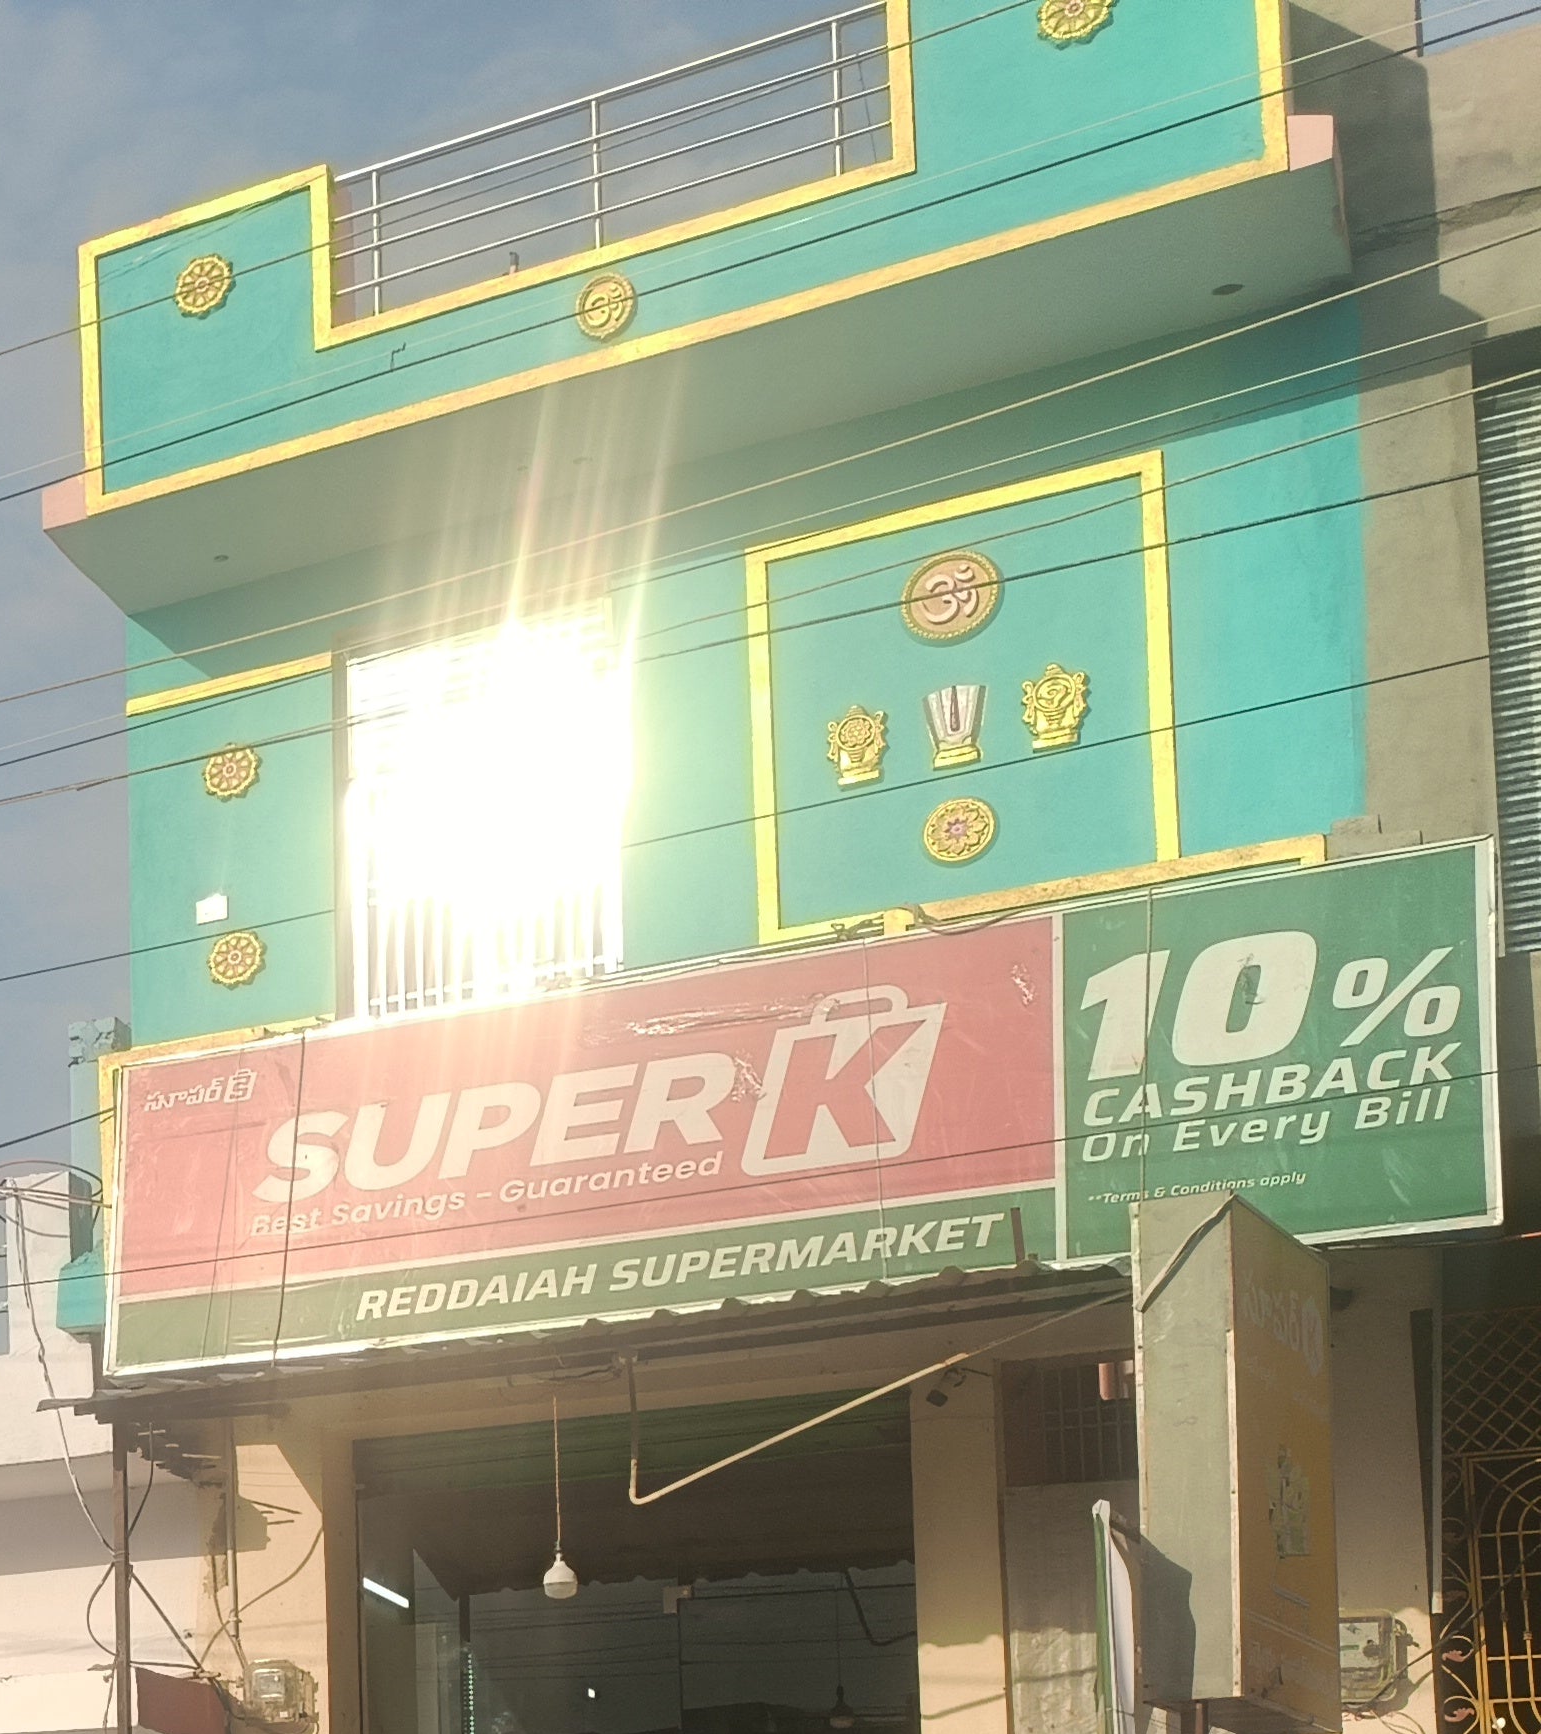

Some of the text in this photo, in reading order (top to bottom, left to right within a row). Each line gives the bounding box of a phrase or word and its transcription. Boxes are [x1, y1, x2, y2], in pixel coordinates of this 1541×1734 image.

[1082, 1085, 1451, 1163] On Every Bill
[1083, 1042, 1462, 1127] CASHBACK
[251, 1052, 735, 1204] SUPER
[251, 1205, 324, 1237] Best
[331, 1188, 466, 1227] Savings
[498, 1151, 723, 1204] Guaranteed
[1170, 1176, 1256, 1197] Conditions
[1259, 1171, 1306, 1189] apply
[355, 1212, 1005, 1322] REDDAIAH SUPERMARKET
